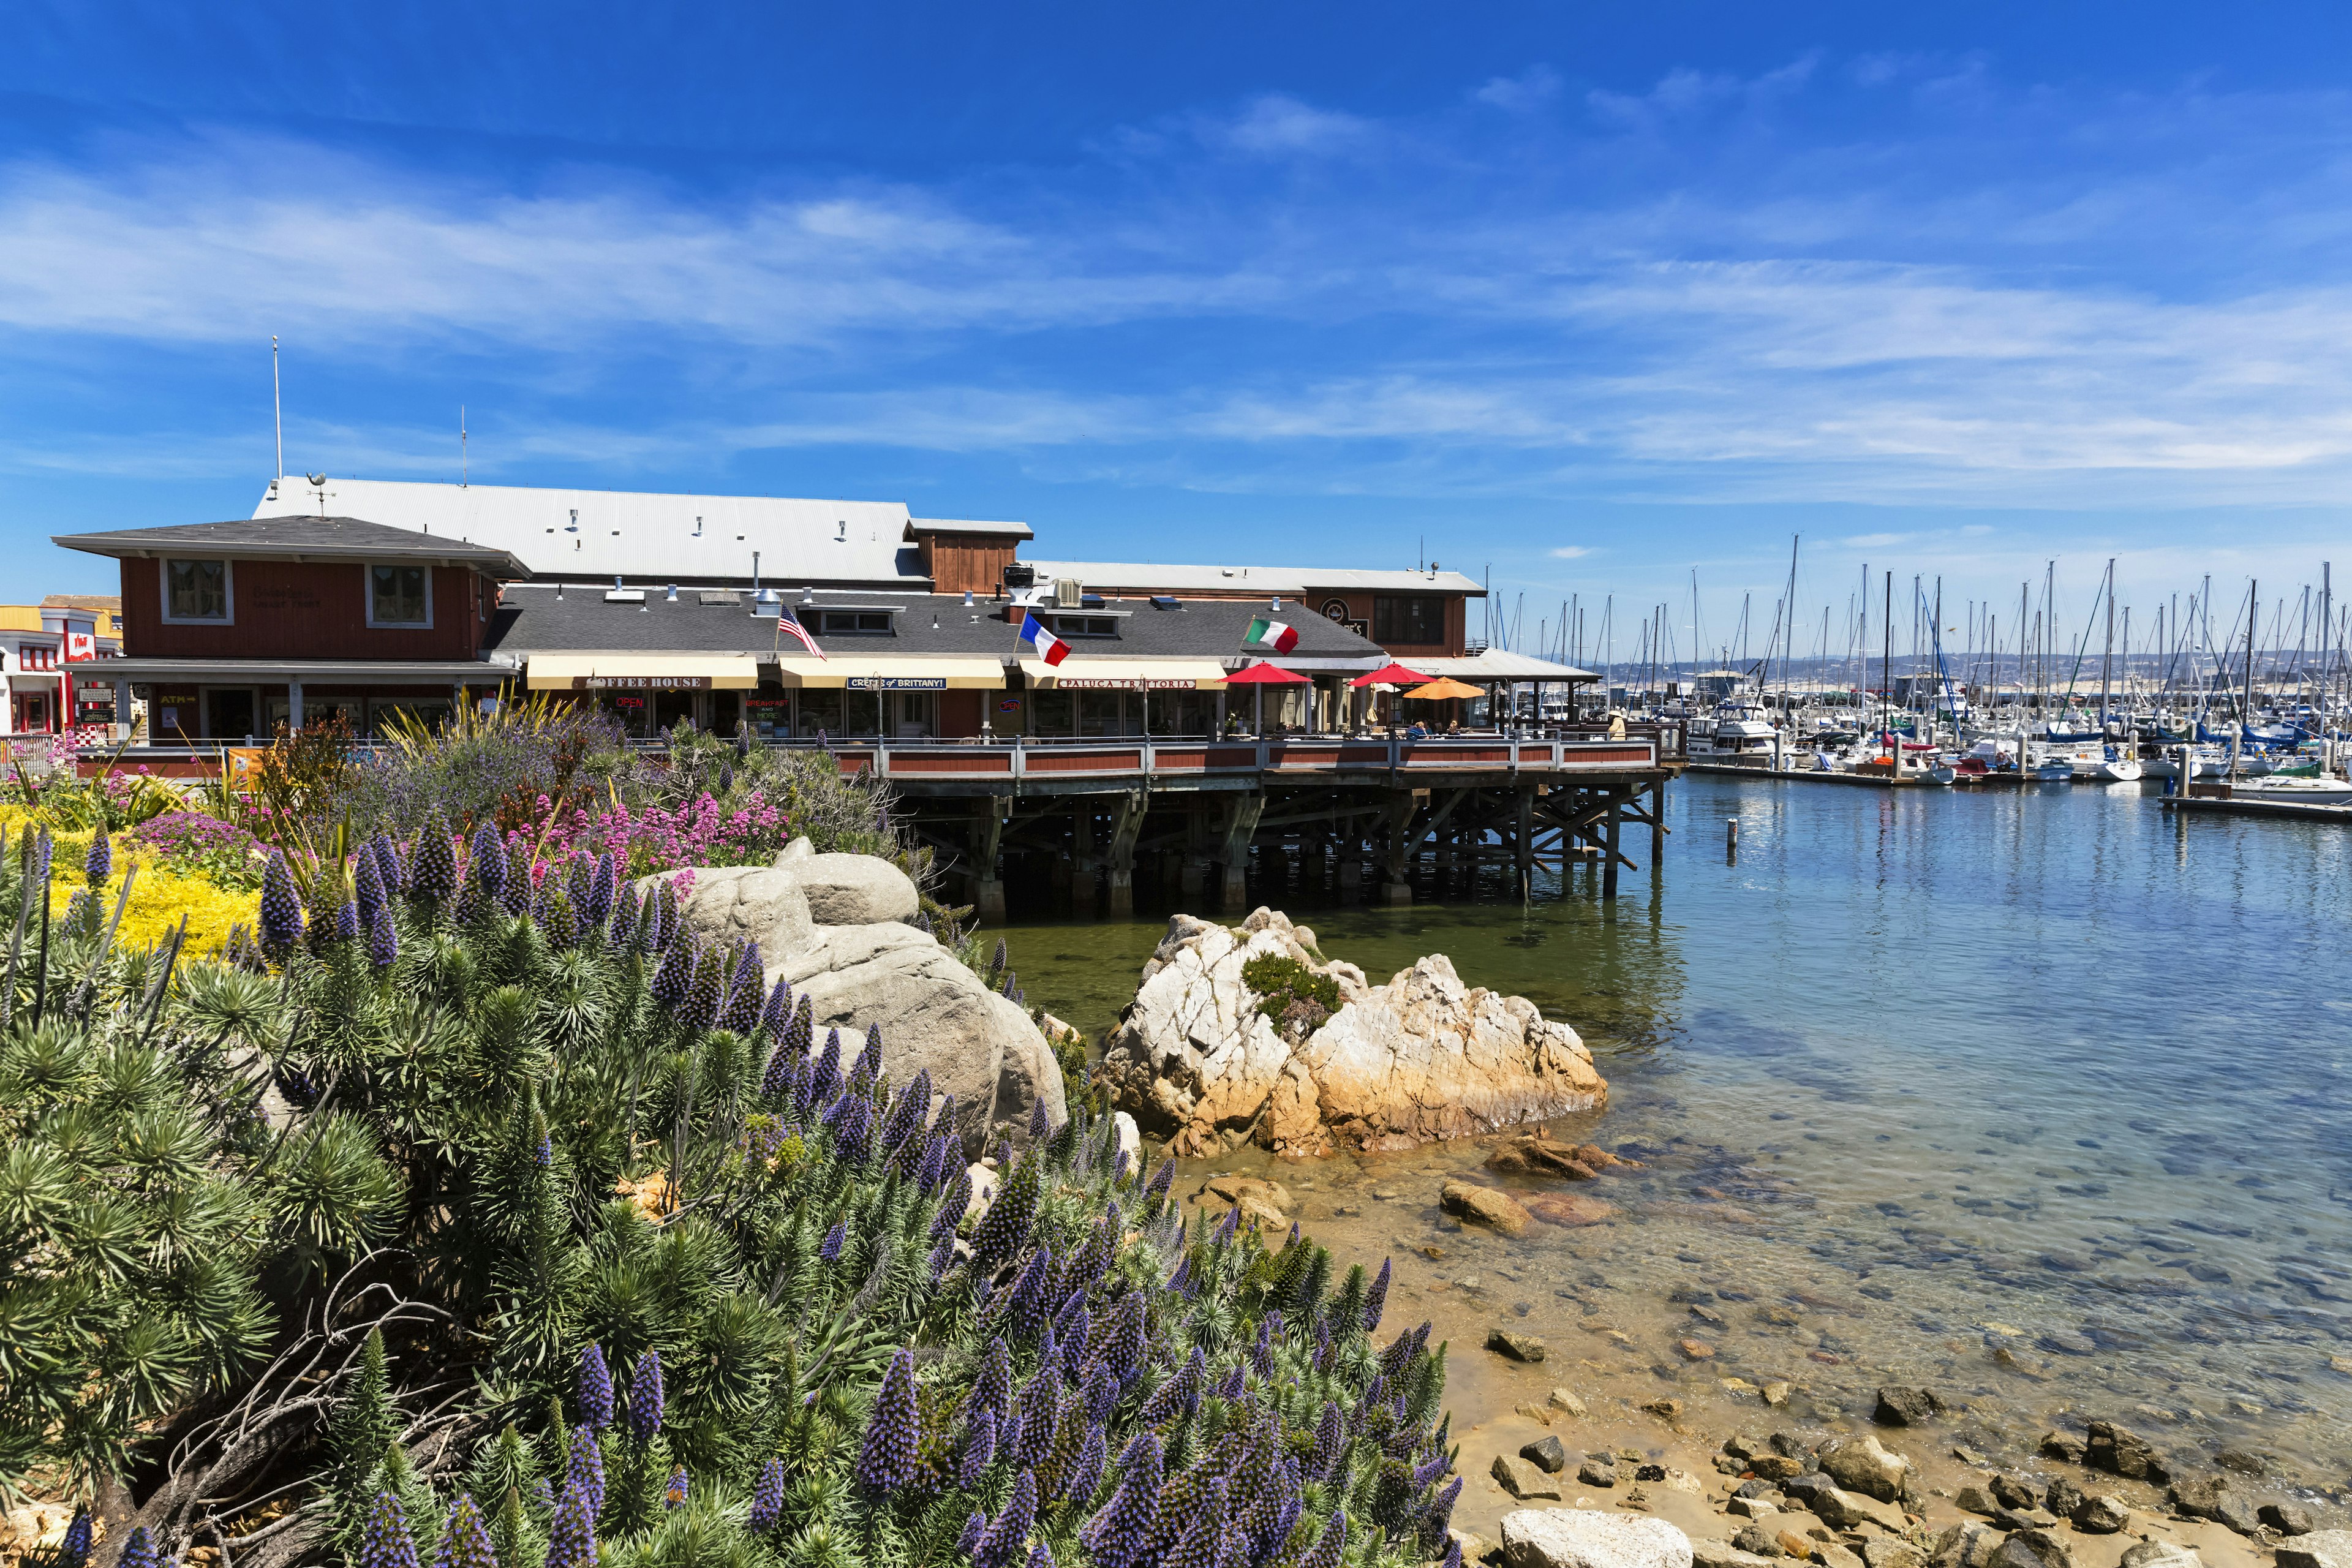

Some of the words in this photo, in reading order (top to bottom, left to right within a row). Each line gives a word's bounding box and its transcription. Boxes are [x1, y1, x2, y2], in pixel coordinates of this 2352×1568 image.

[651, 677, 700, 687] HOUSE
[886, 679, 897, 687] of
[617, 698, 643, 707] OPEN
